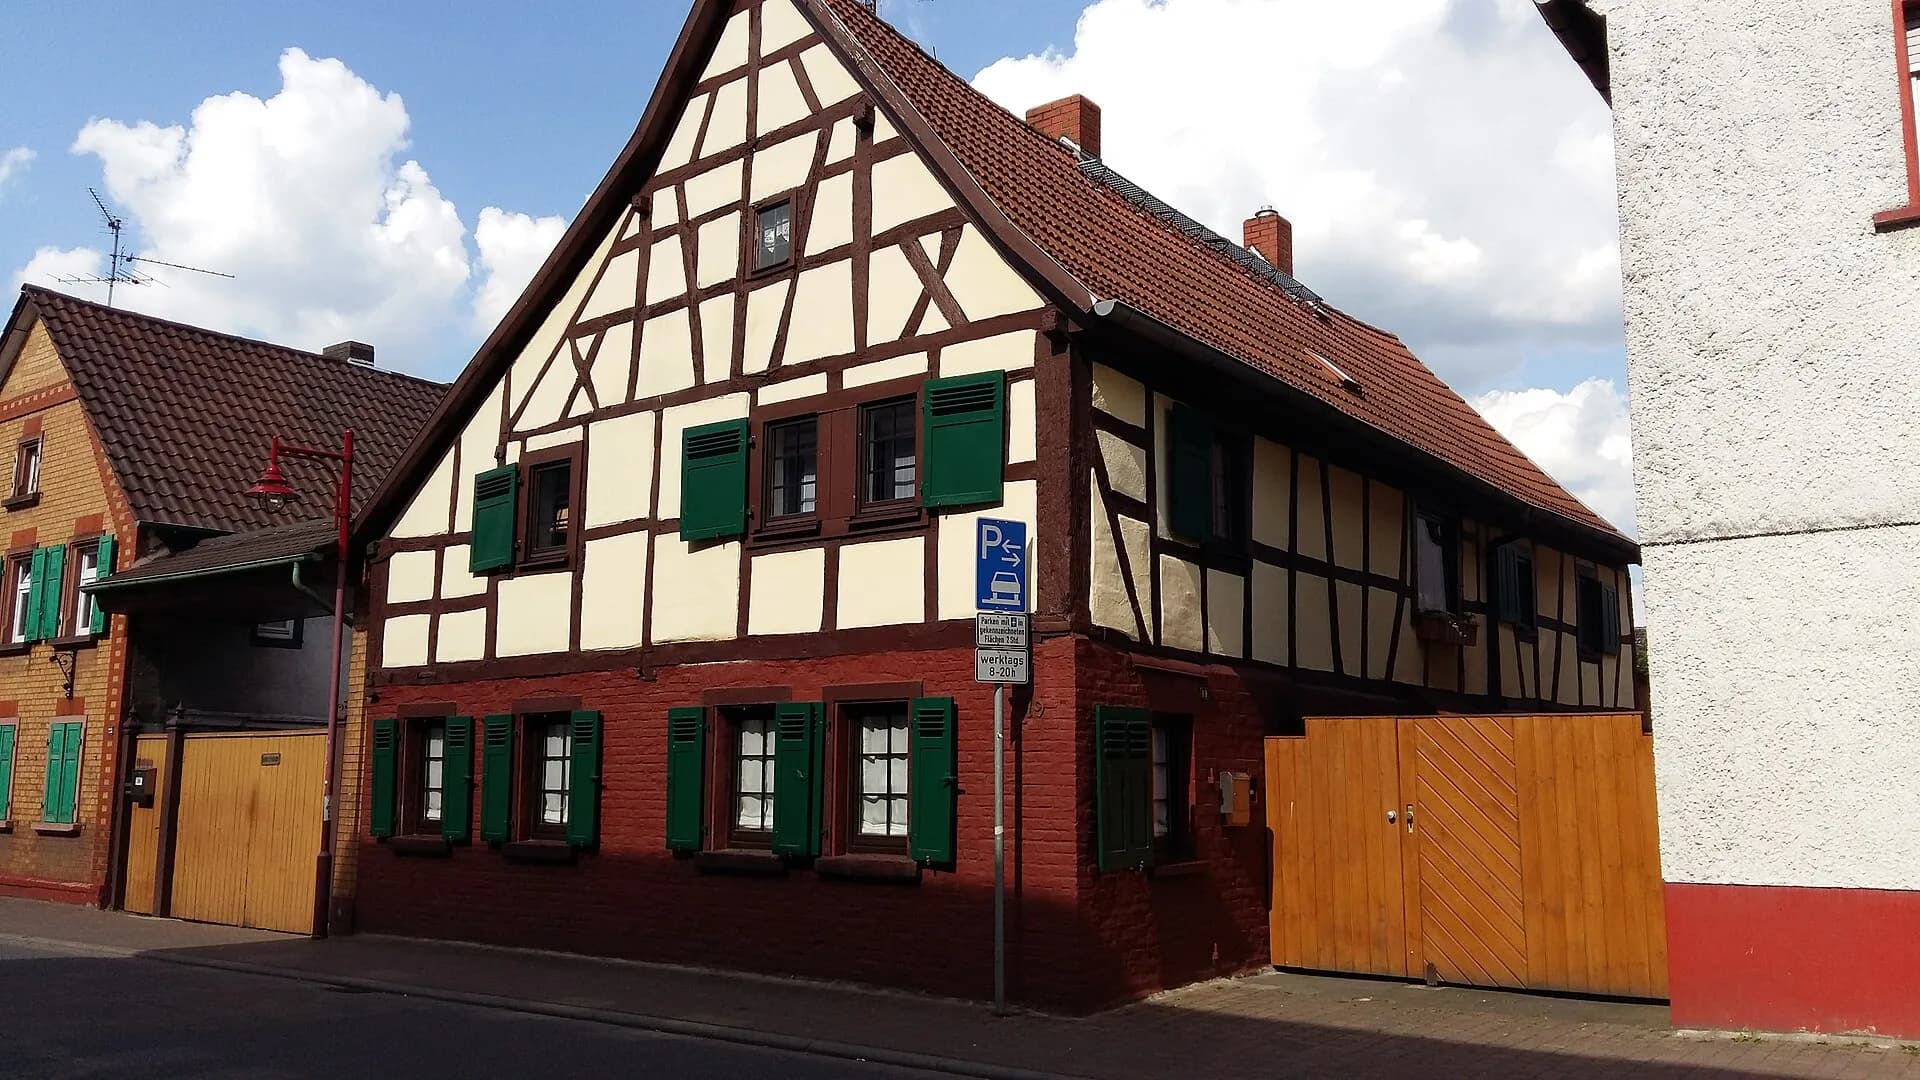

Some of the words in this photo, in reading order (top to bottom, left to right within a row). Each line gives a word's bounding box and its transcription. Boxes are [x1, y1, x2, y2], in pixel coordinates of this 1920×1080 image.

[982, 524, 1003, 560] P
[981, 616, 1000, 625] Parken
[1000, 617, 1010, 626] mit
[979, 625, 1025, 636] gekennzeichneten
[980, 655, 1024, 668] werktags
